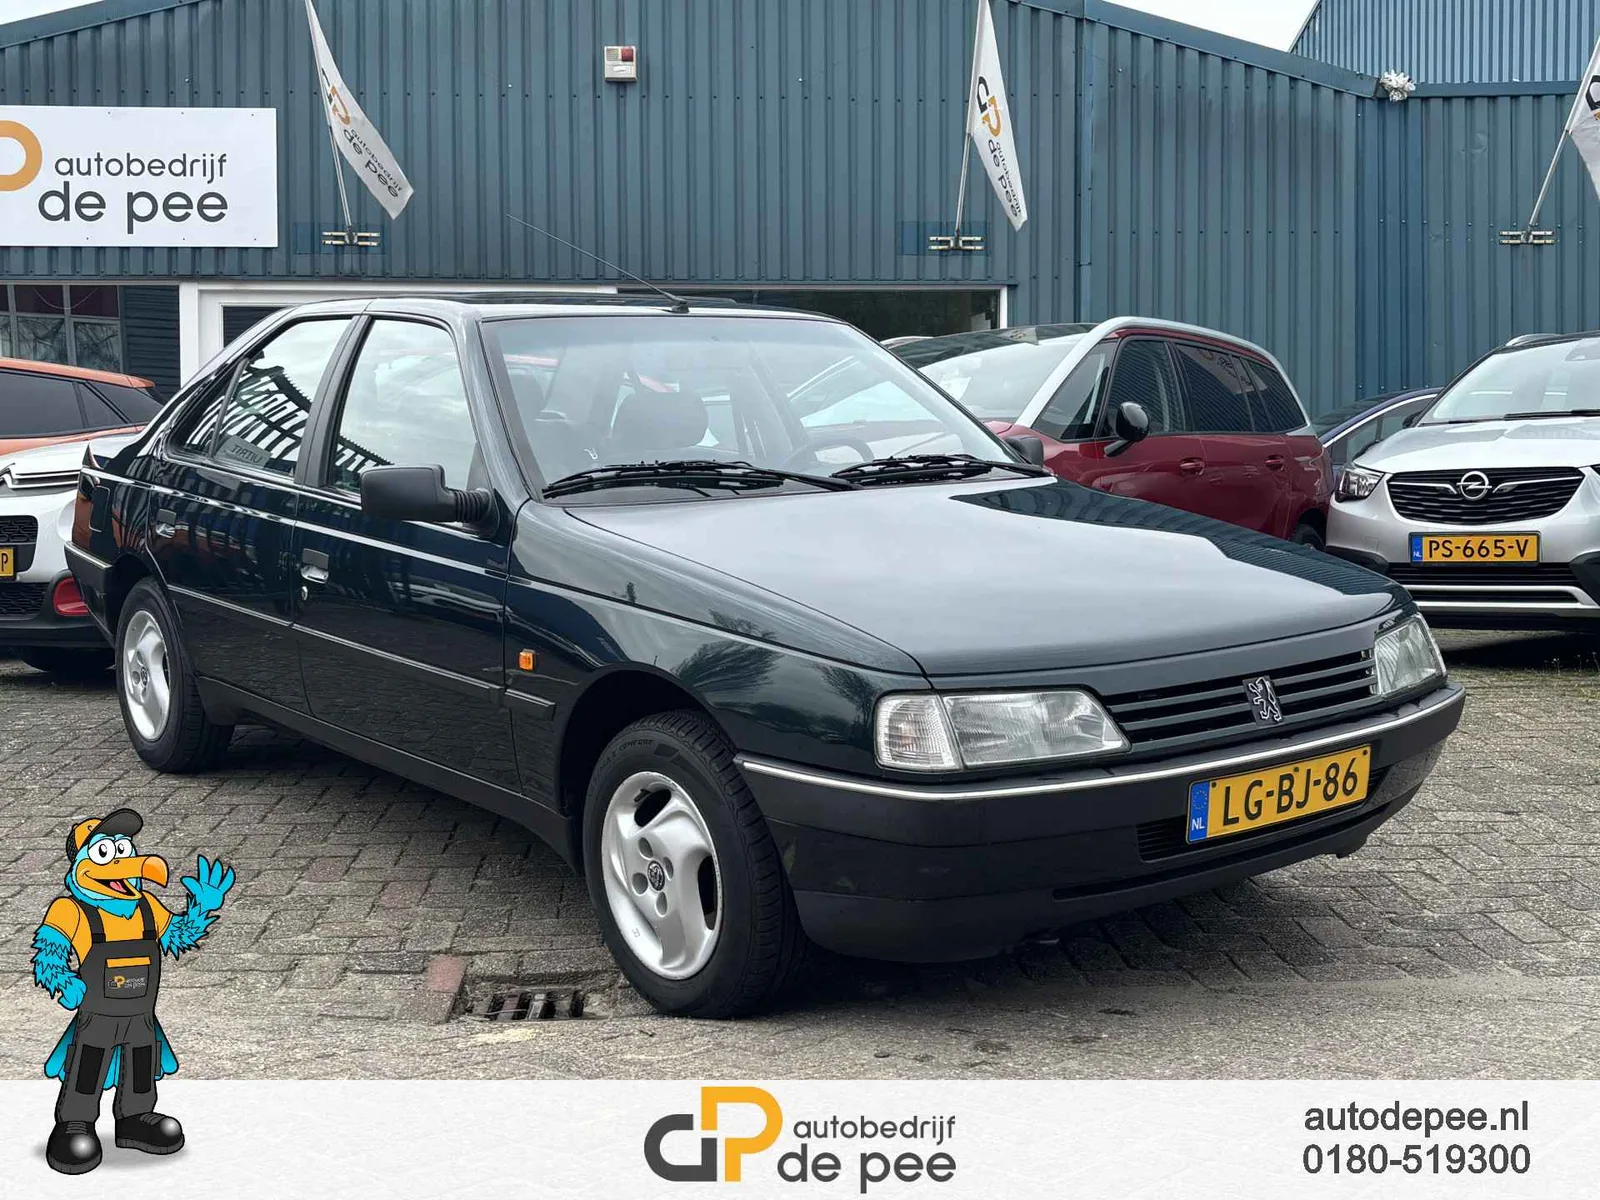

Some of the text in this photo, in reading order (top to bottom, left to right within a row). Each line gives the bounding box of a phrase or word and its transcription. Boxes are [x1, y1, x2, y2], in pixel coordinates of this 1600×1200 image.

[54, 152, 227, 185] autobedrijf
[343, 128, 399, 198] de pee
[988, 139, 1018, 217] de pee
[38, 180, 228, 235] de pee
[1428, 538, 1529, 559] PS-665-V
[1191, 757, 1358, 832] NL LG-BJ-86
